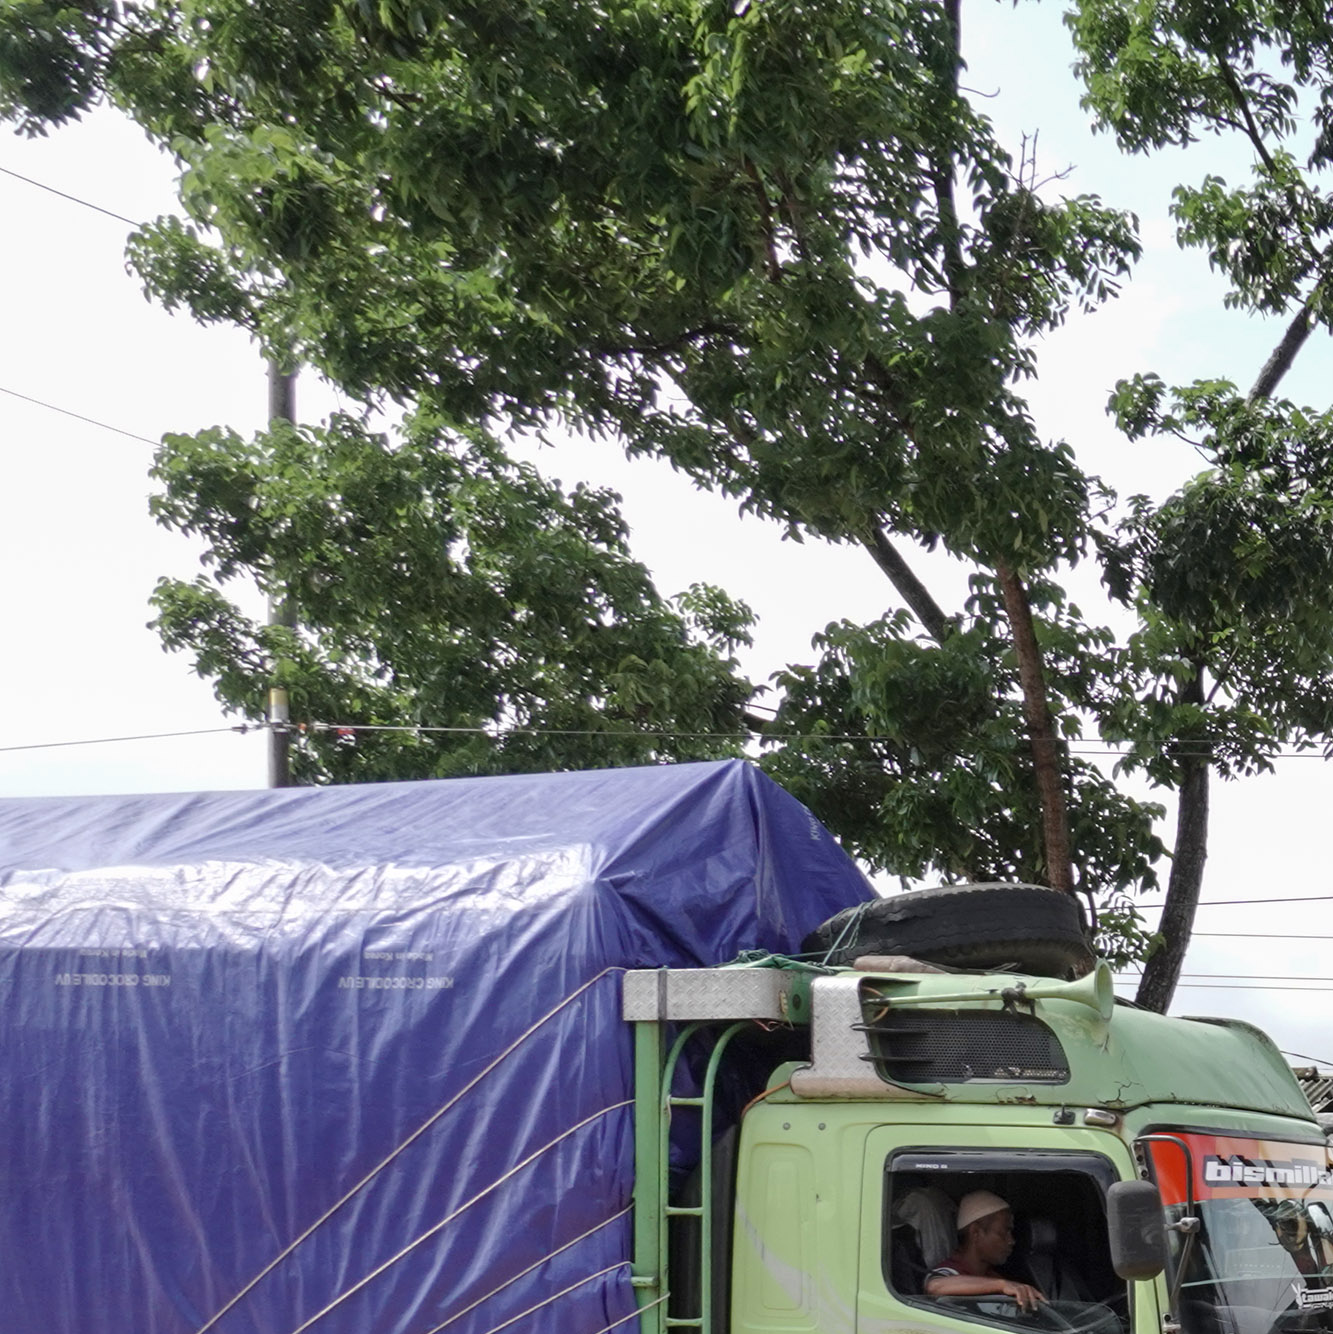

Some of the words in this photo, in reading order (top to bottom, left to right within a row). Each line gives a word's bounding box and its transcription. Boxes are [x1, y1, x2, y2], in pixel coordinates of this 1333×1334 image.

[72, 973, 140, 987] CROCODILE
[142, 974, 171, 987] KING
[356, 976, 425, 989] CROCODILE
[426, 976, 454, 989] KING
